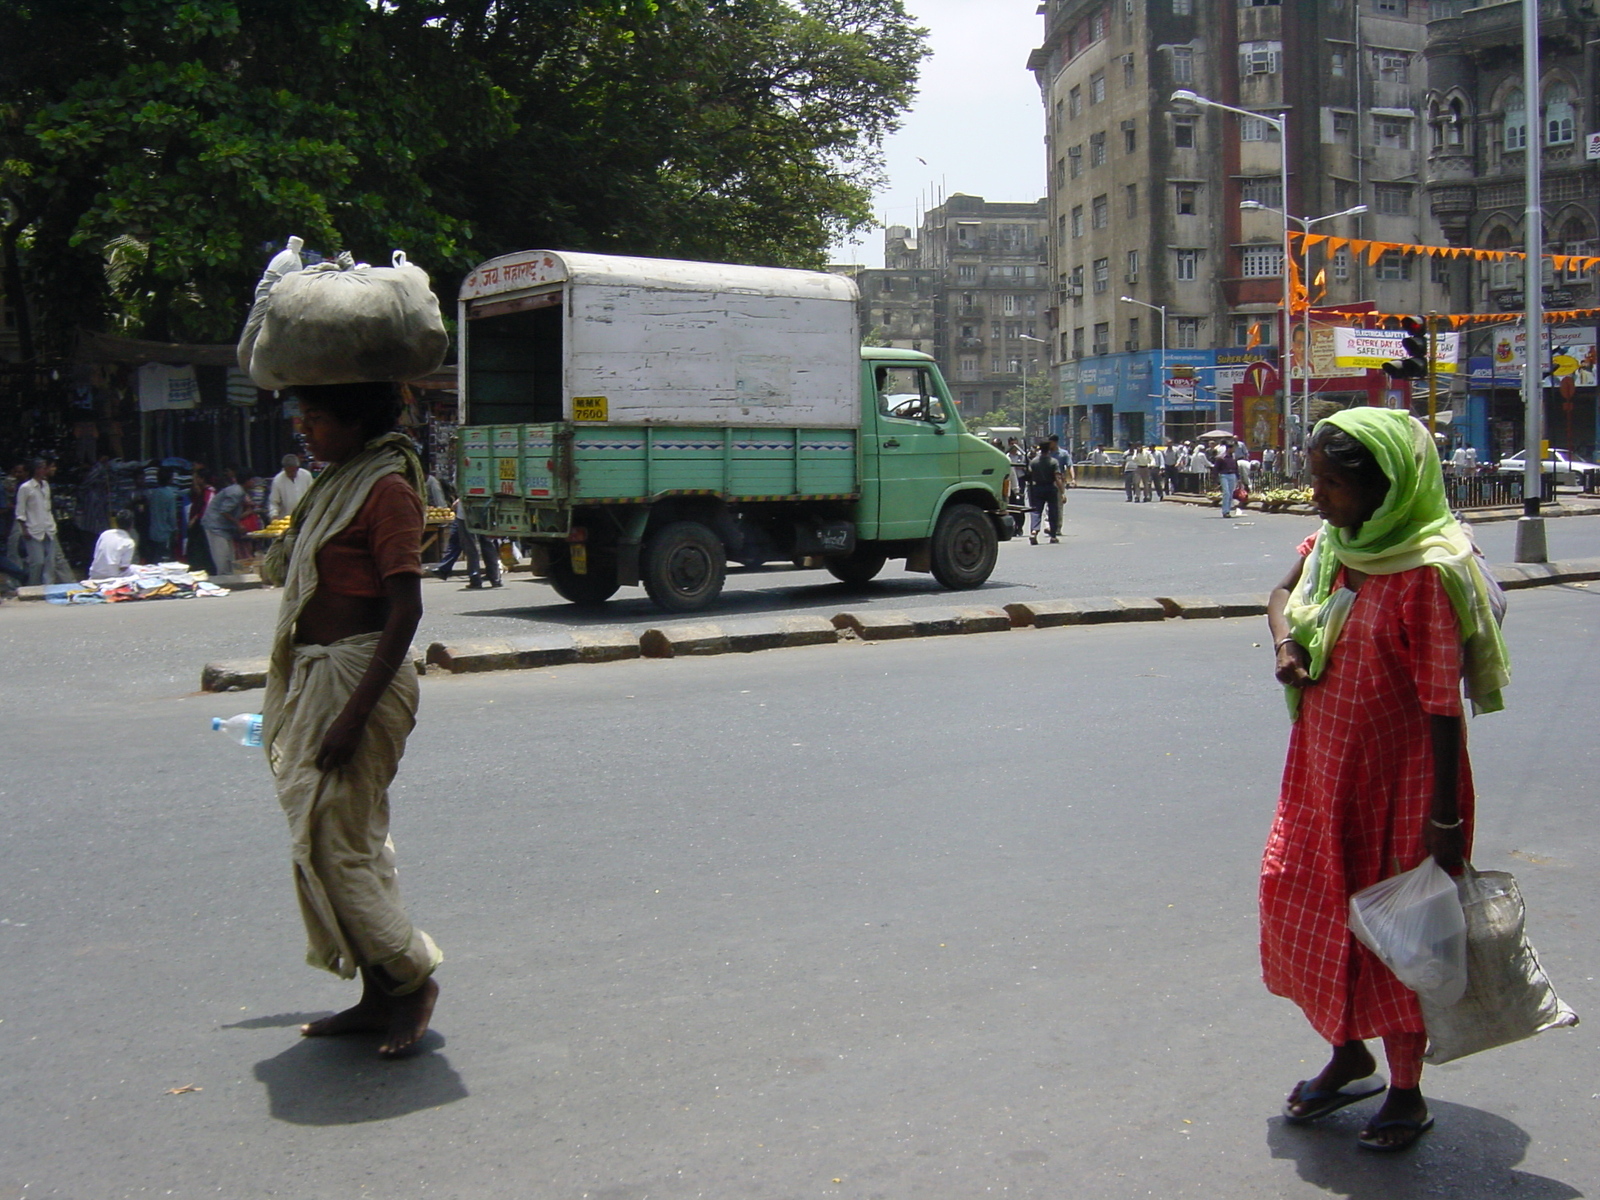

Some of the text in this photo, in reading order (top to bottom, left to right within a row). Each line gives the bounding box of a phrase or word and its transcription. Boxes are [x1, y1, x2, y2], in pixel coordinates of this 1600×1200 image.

[481, 267, 499, 287] जय
[1356, 338, 1378, 347] EVERY
[1441, 343, 1453, 352] DAY
[1356, 347, 1404, 357] SAFETY HAS
[499, 514, 529, 525] TATA
